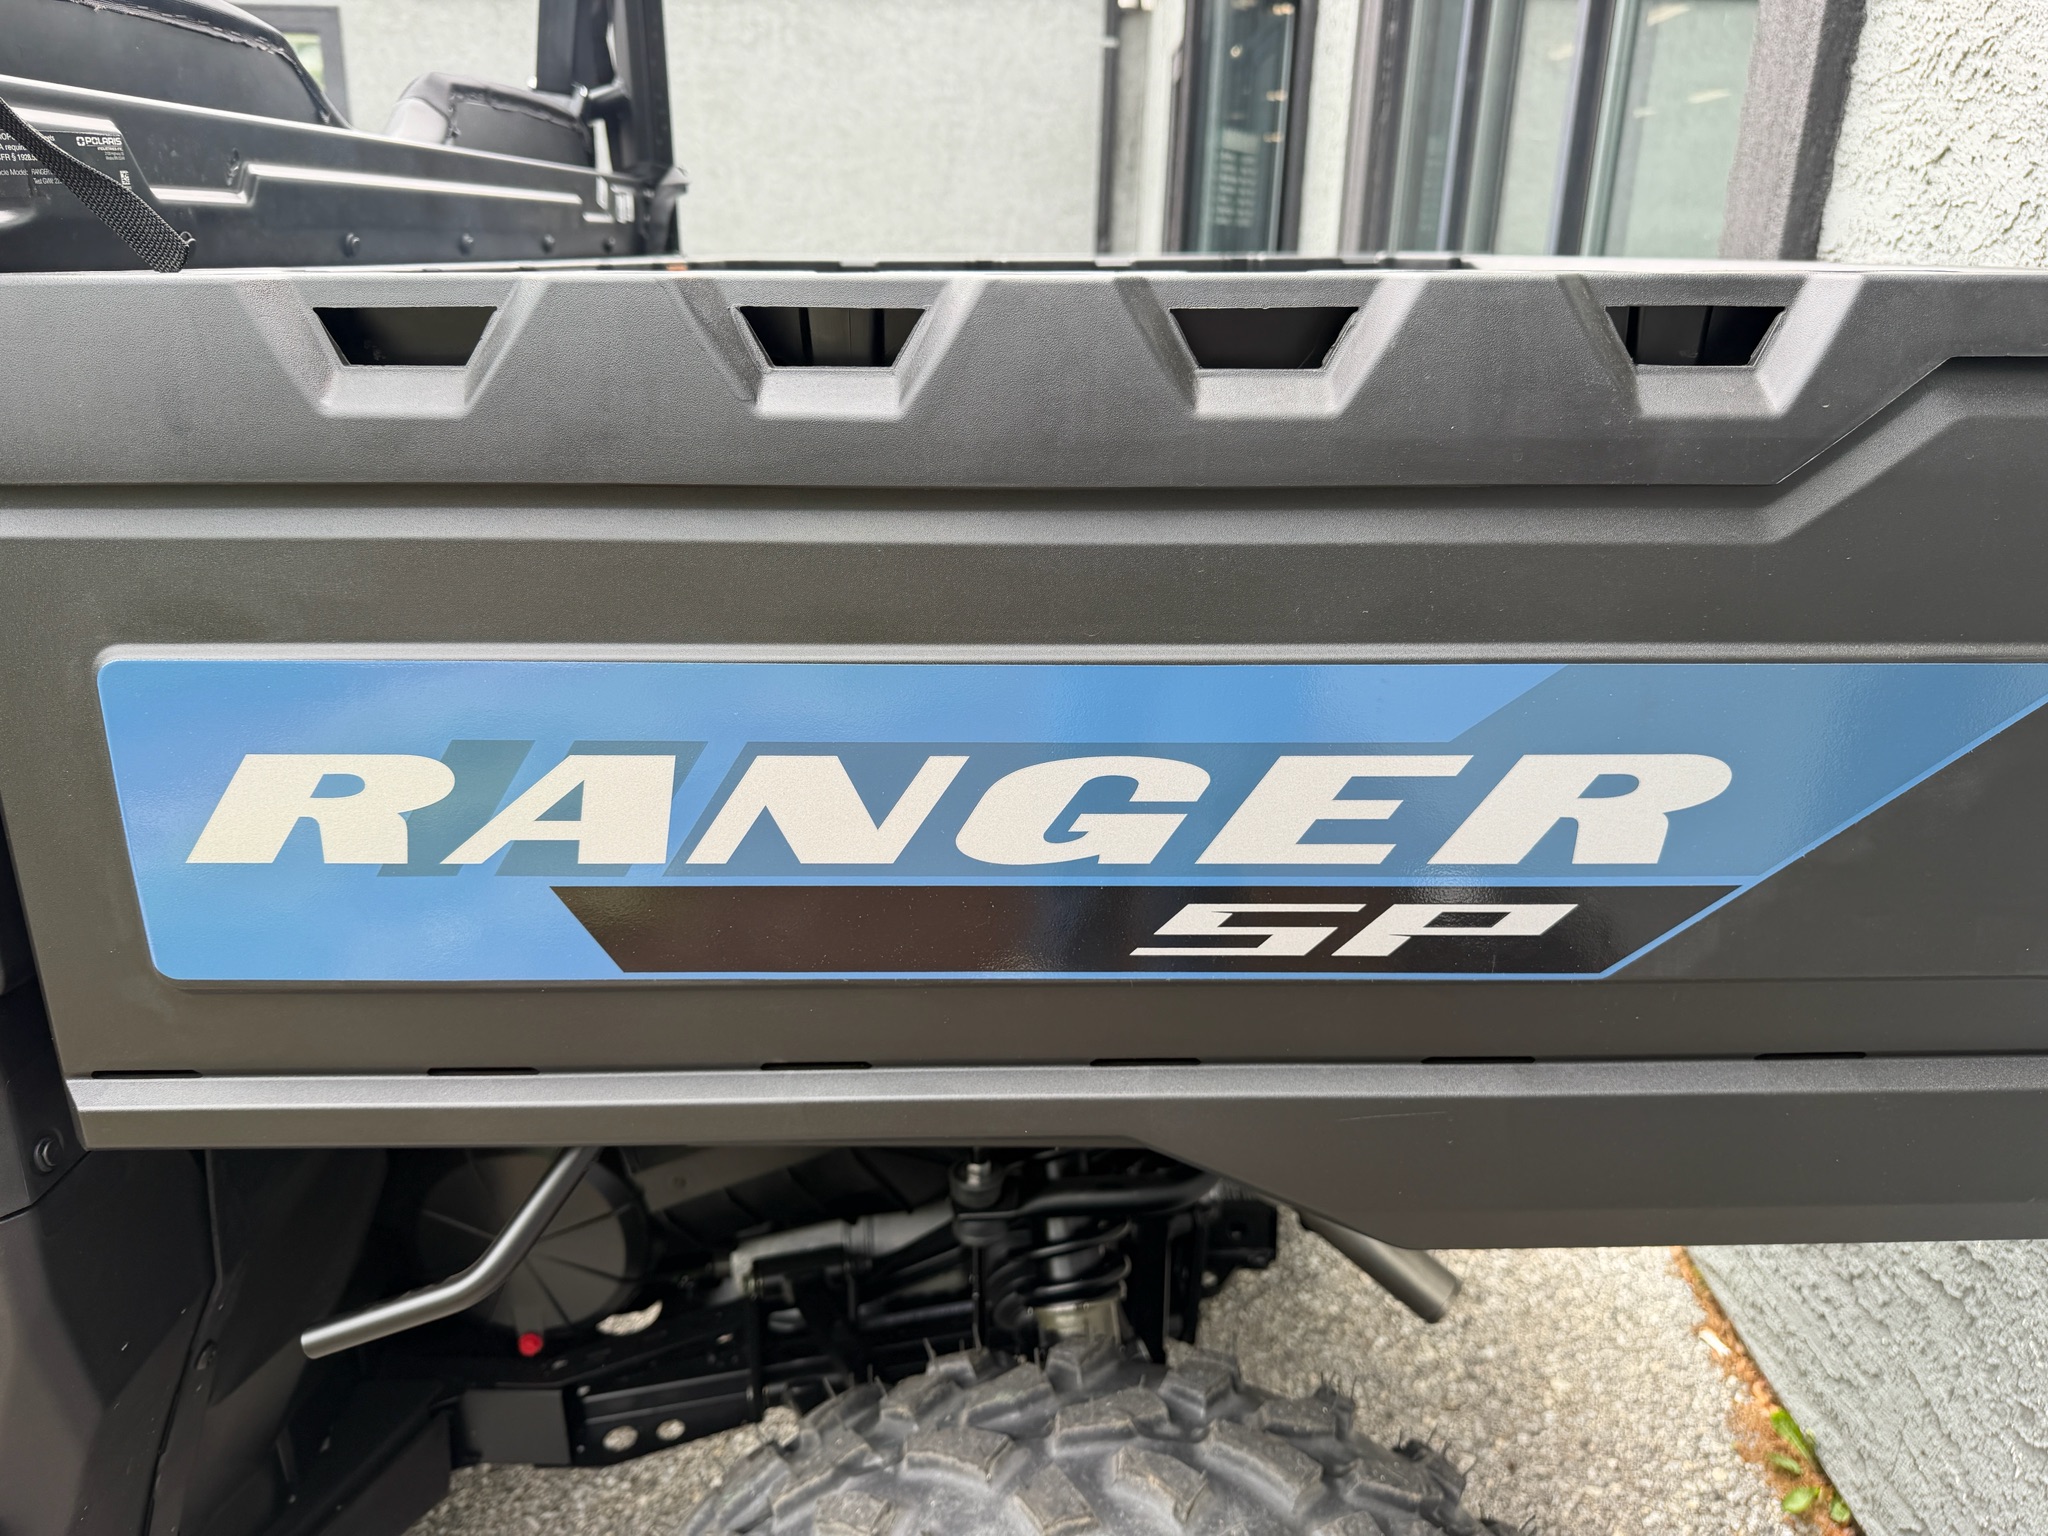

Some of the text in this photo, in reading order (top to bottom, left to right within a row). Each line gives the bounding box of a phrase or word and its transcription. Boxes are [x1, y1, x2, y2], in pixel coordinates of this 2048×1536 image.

[85, 137, 122, 146] POLARIS
[10, 168, 28, 176] Model:
[186, 753, 1733, 867] RANGER
[1130, 903, 1578, 957] SP
